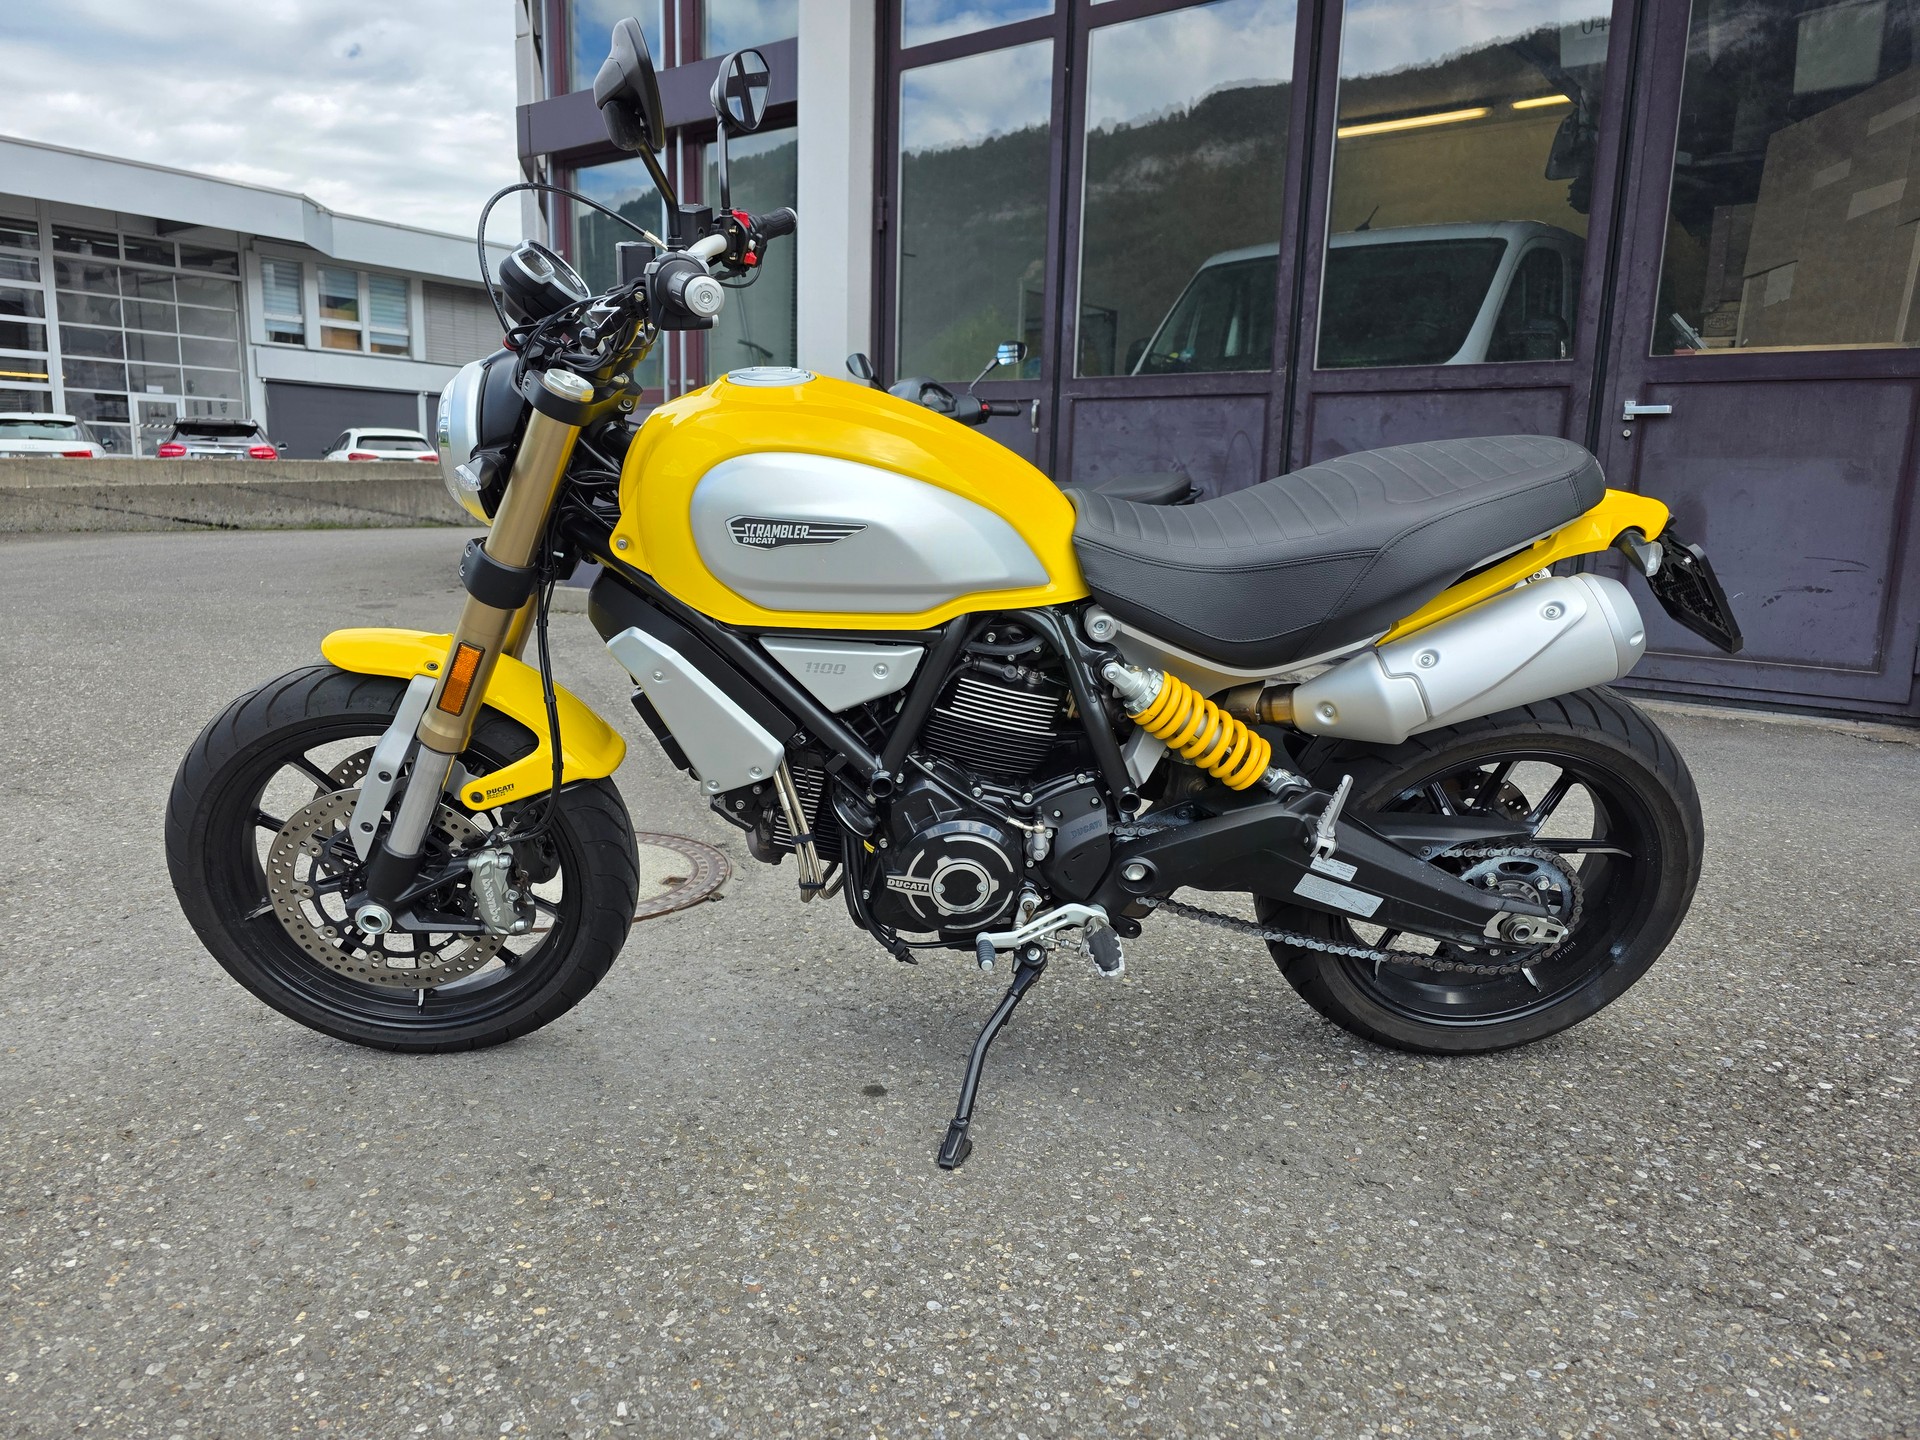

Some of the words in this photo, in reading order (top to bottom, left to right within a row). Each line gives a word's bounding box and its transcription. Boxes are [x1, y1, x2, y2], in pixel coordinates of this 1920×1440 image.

[744, 523, 810, 539] SCRAMBLER
[742, 536, 776, 545] DUCATI
[804, 661, 847, 675] 1100
[486, 783, 514, 795] DUCATI
[1070, 819, 1103, 840] DUCATI
[887, 878, 929, 892] DUCATI
[481, 878, 501, 923] brembo
